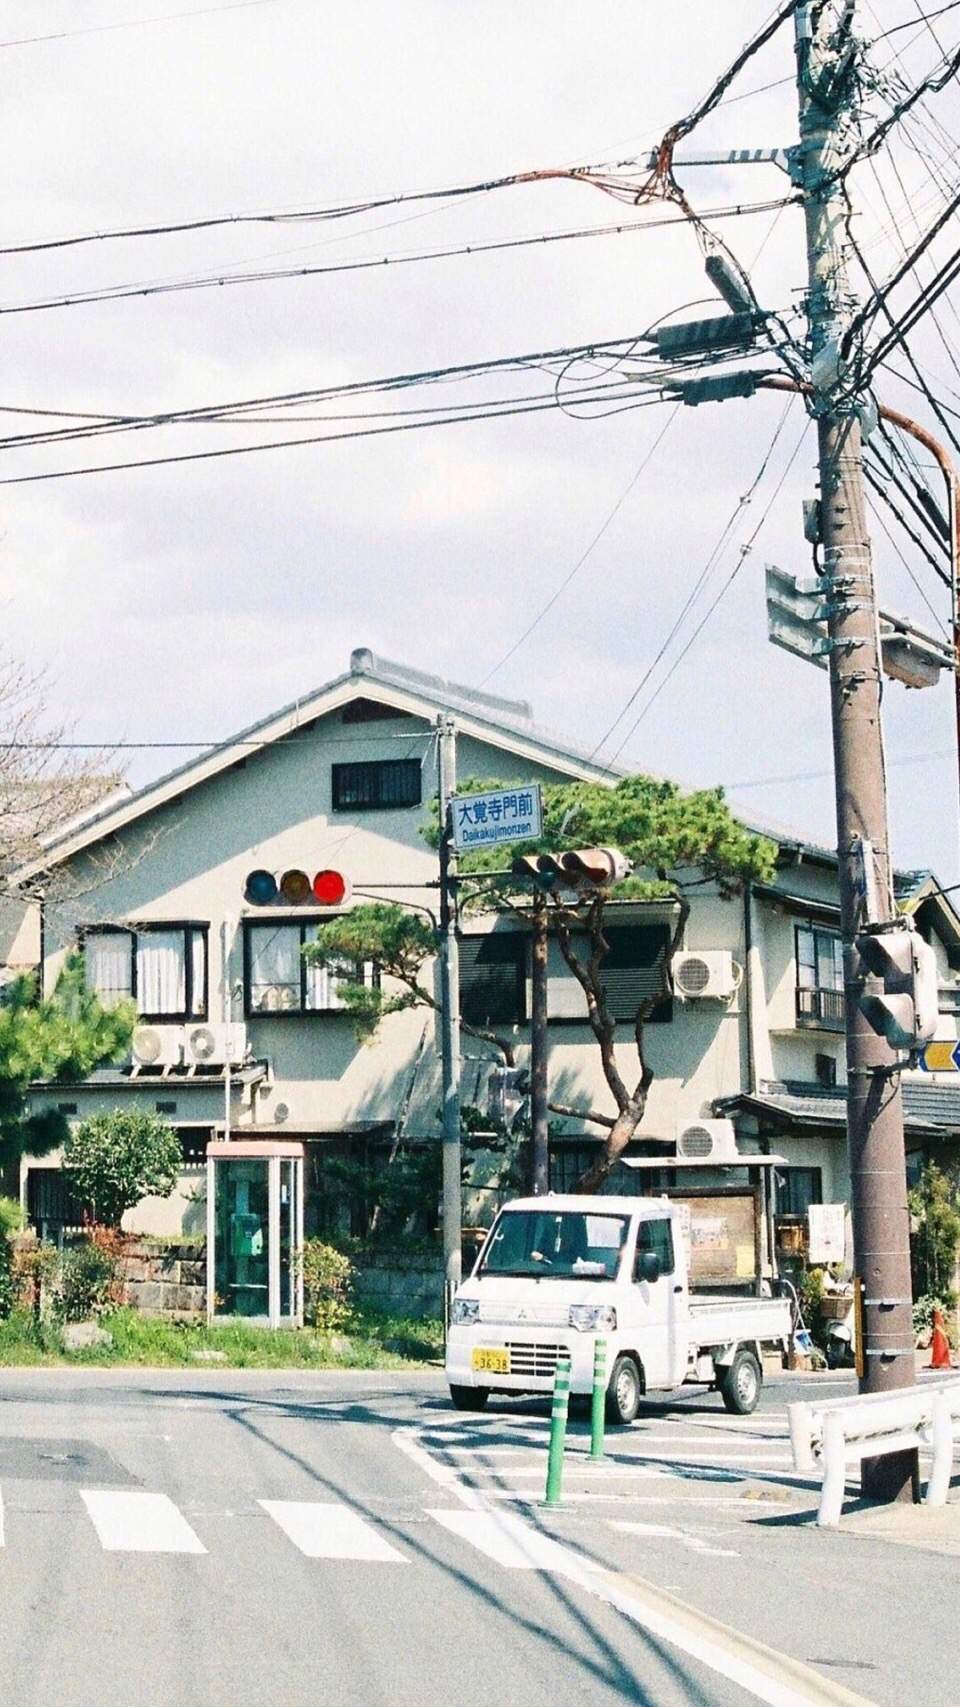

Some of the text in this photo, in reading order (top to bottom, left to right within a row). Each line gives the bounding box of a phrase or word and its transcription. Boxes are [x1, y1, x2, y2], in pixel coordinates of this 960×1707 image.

[458, 792, 533, 826] 大覚寺門前
[463, 823, 532, 842] Daikakujimonzen
